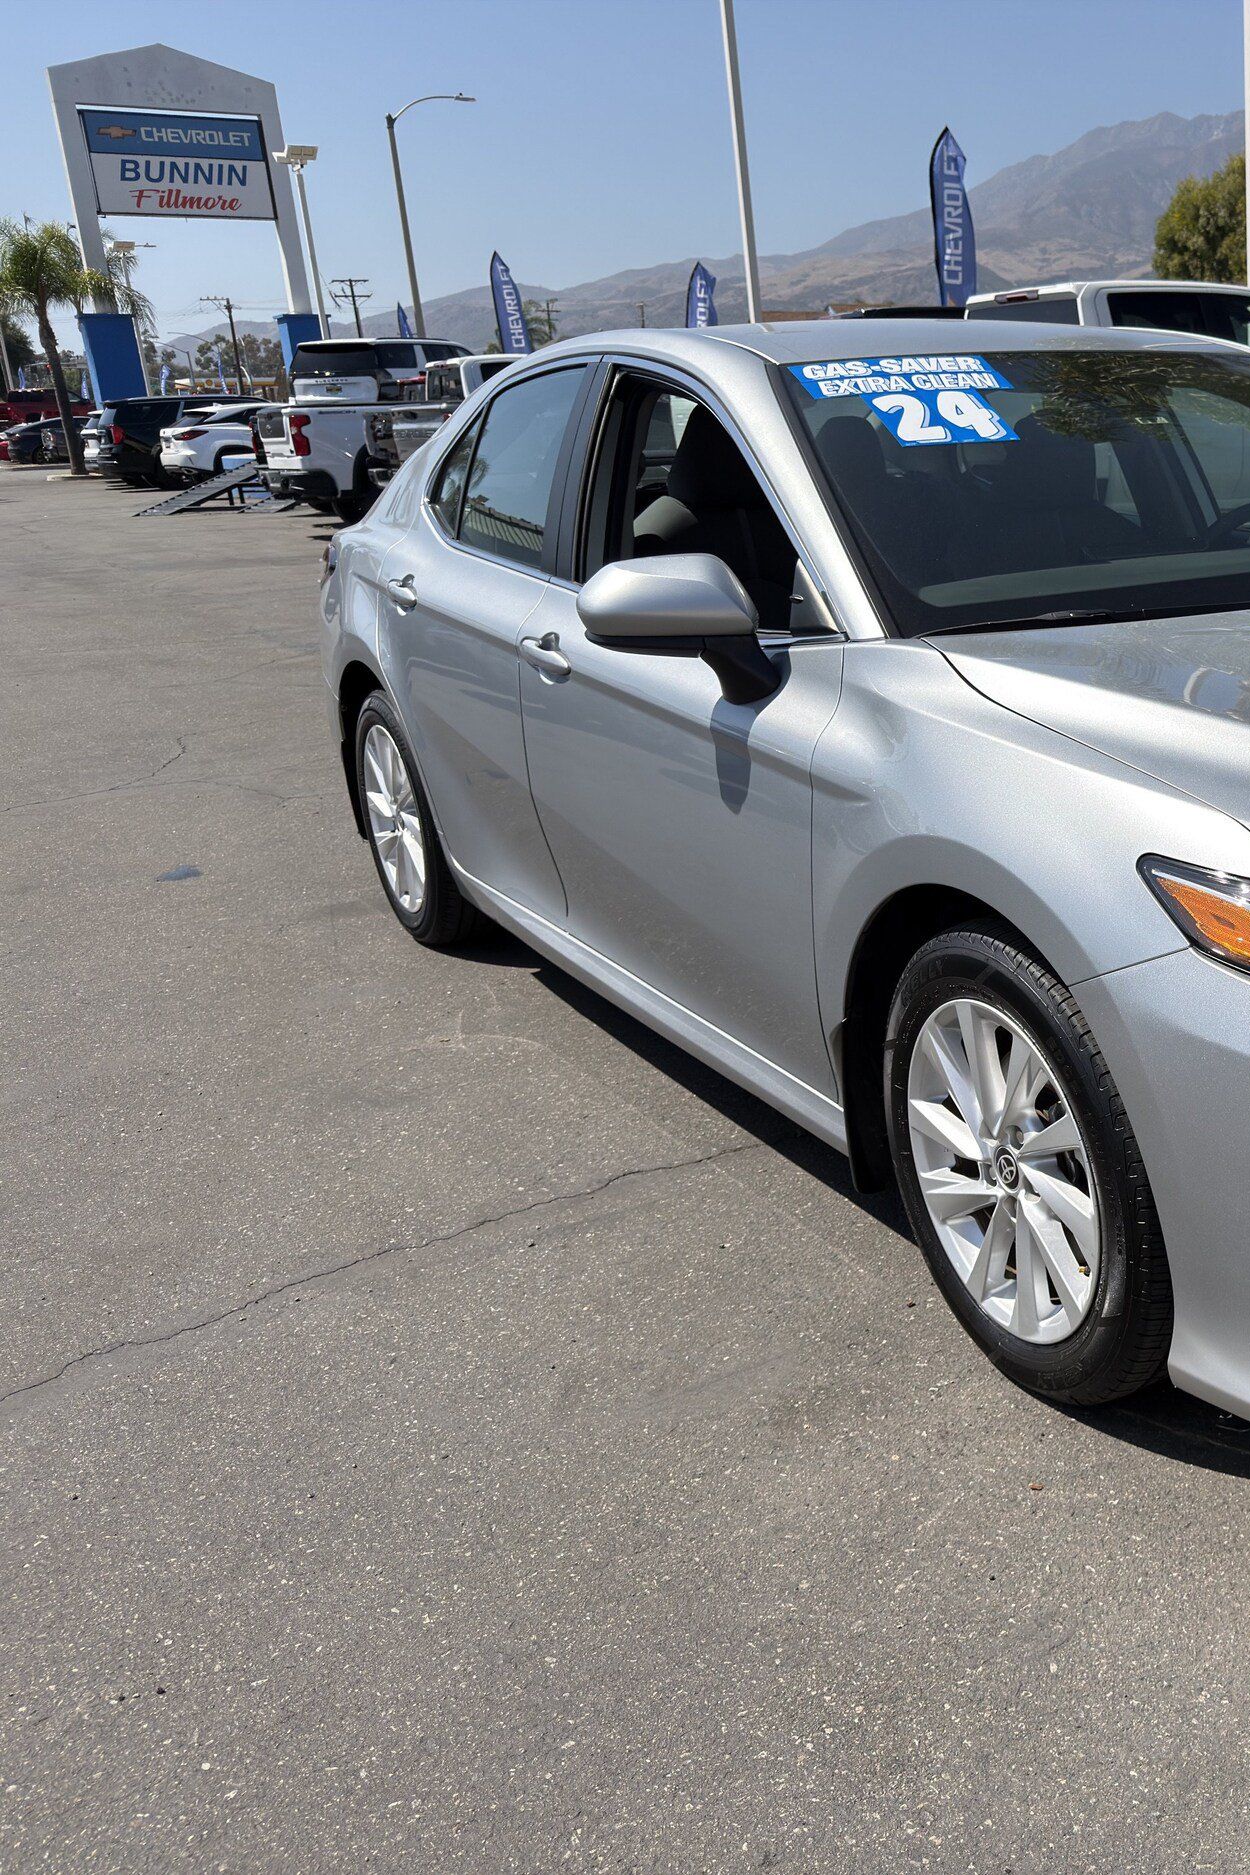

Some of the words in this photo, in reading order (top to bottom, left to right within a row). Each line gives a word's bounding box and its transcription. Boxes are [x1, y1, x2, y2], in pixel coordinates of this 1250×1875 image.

[139, 126, 251, 147] CHEVROLET
[120, 159, 247, 187] BUNNIN
[129, 188, 242, 212] Fillmore
[802, 357, 985, 381] GAS-SAVER
[817, 377, 916, 397] EXTRA
[911, 374, 1000, 391] CLEAN
[871, 391, 1007, 443] 24
